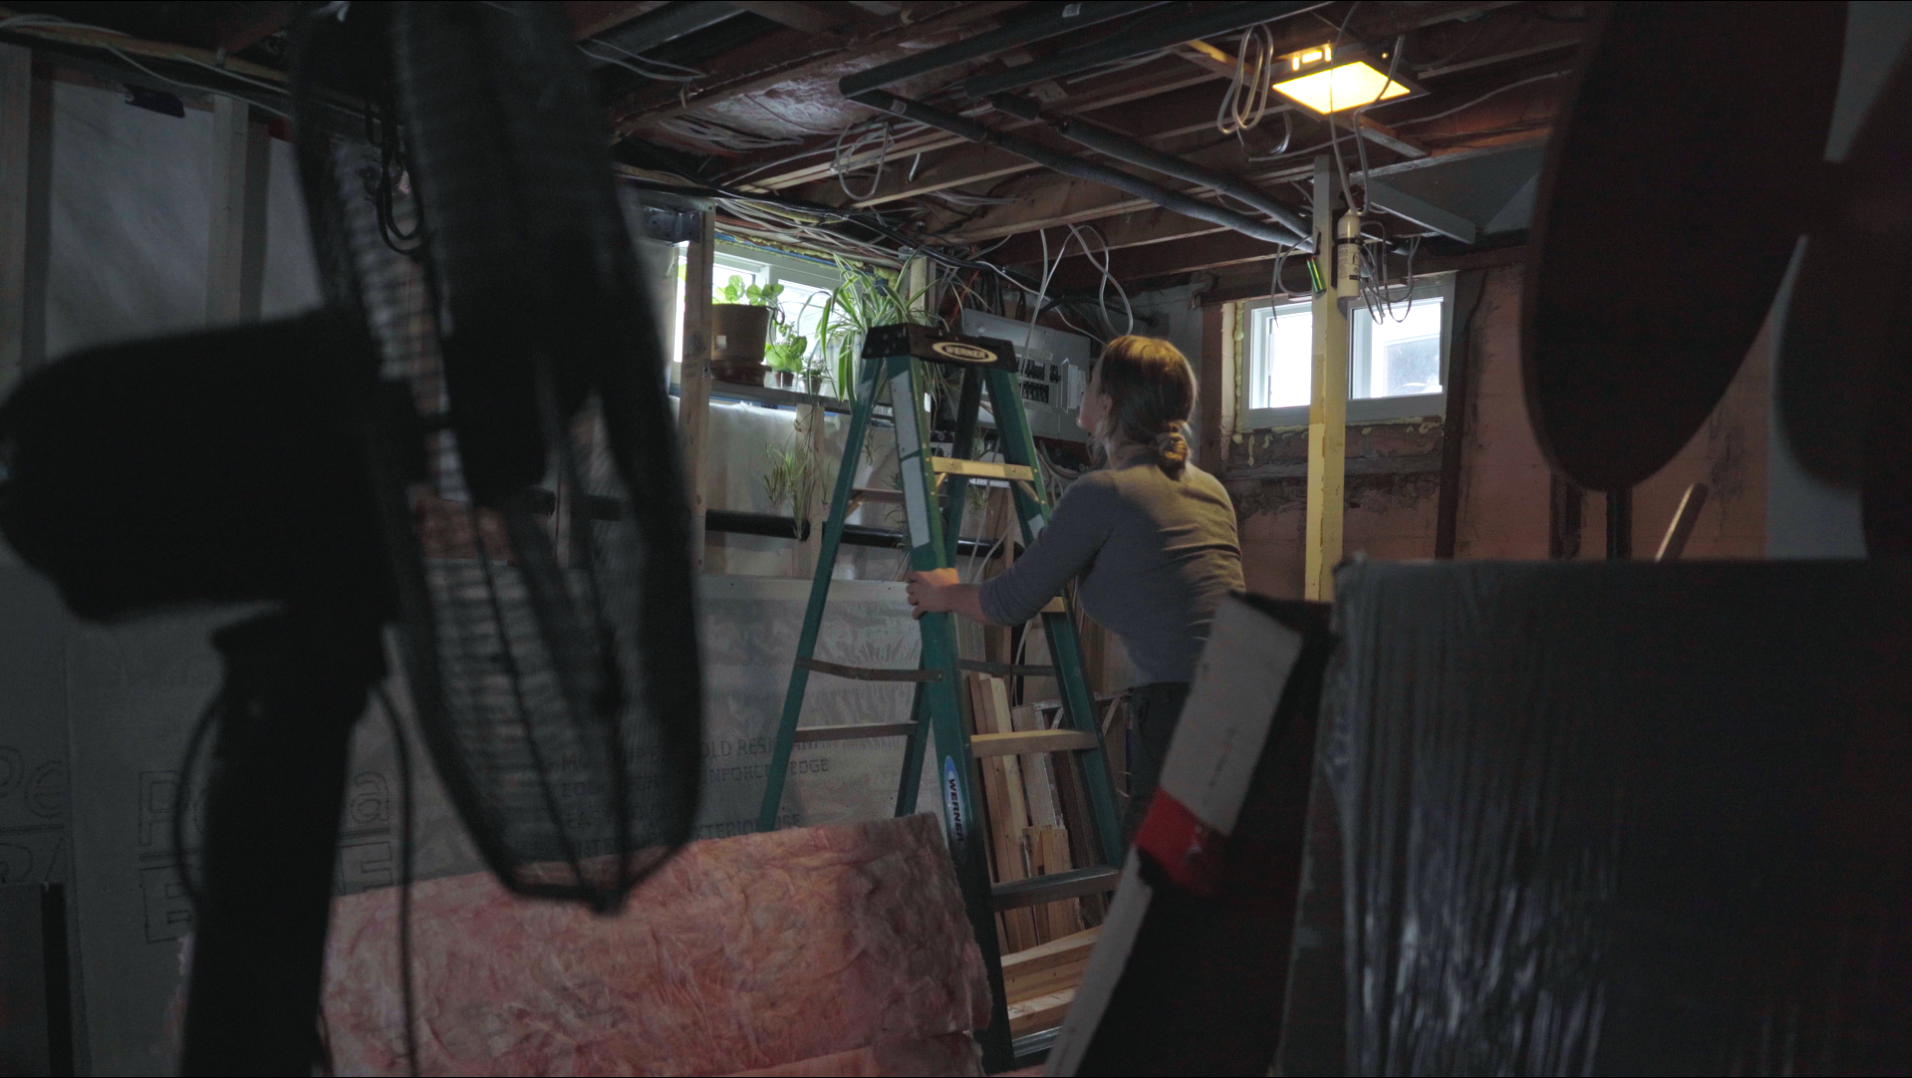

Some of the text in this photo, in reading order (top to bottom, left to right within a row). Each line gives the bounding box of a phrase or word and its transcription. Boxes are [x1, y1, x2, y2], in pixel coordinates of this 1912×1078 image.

[944, 344, 986, 360] WERNER
[789, 758, 829, 775] EDGE
[949, 778, 964, 842] WERNER
